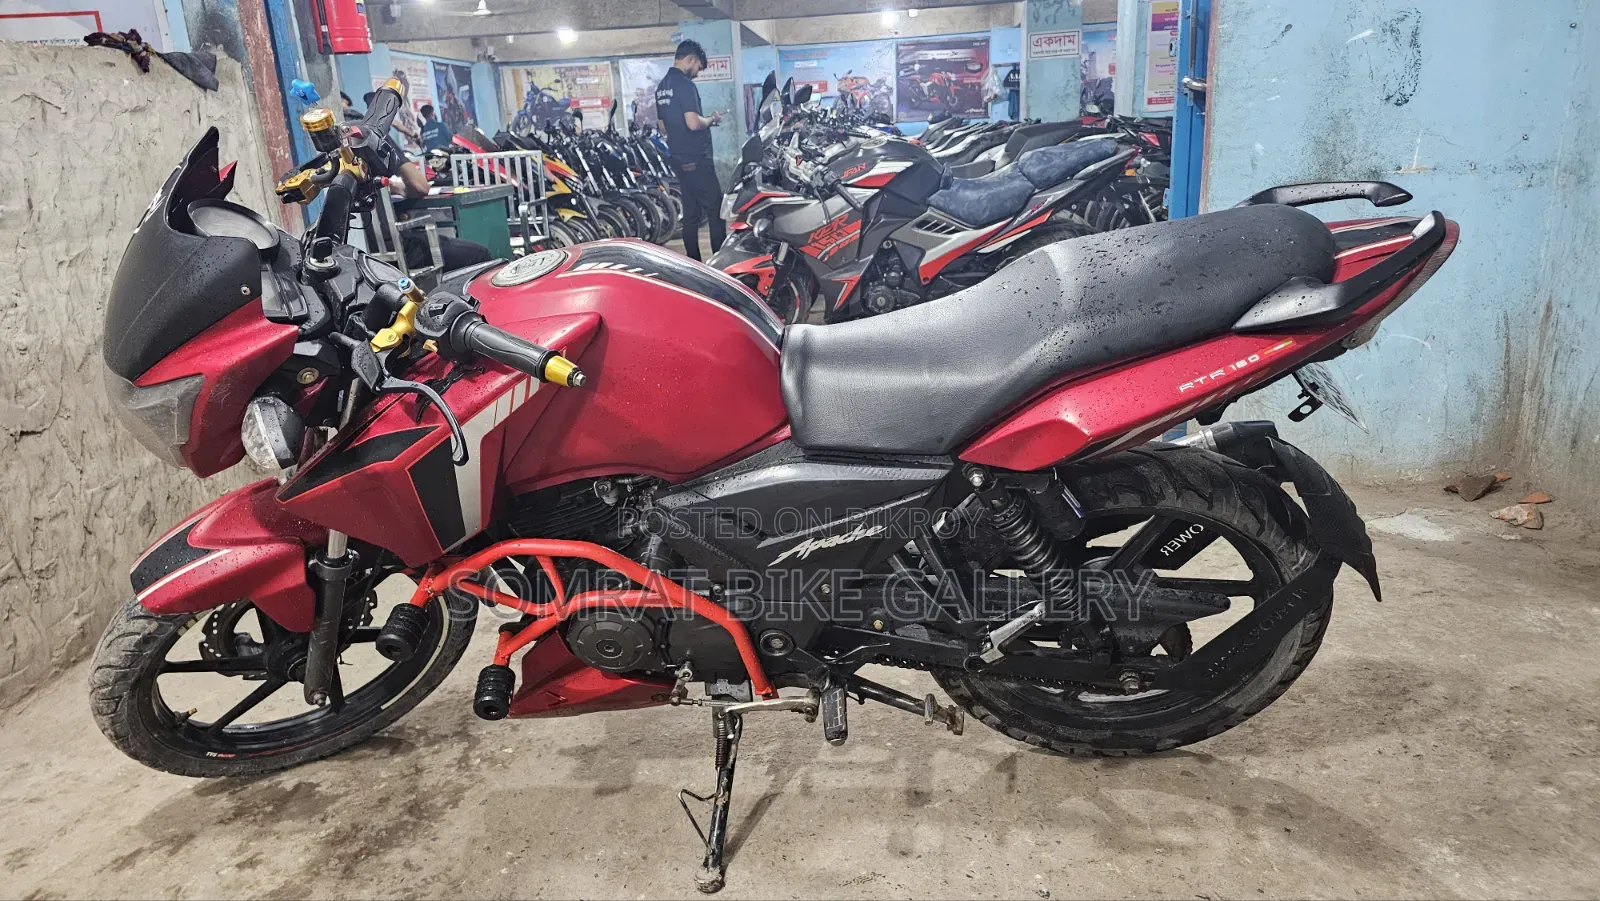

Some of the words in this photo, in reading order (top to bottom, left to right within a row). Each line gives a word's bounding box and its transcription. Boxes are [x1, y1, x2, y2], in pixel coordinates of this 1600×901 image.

[1033, 34, 1077, 48] একদাম
[1178, 368, 1226, 393] RTR
[767, 523, 889, 567] Apache
